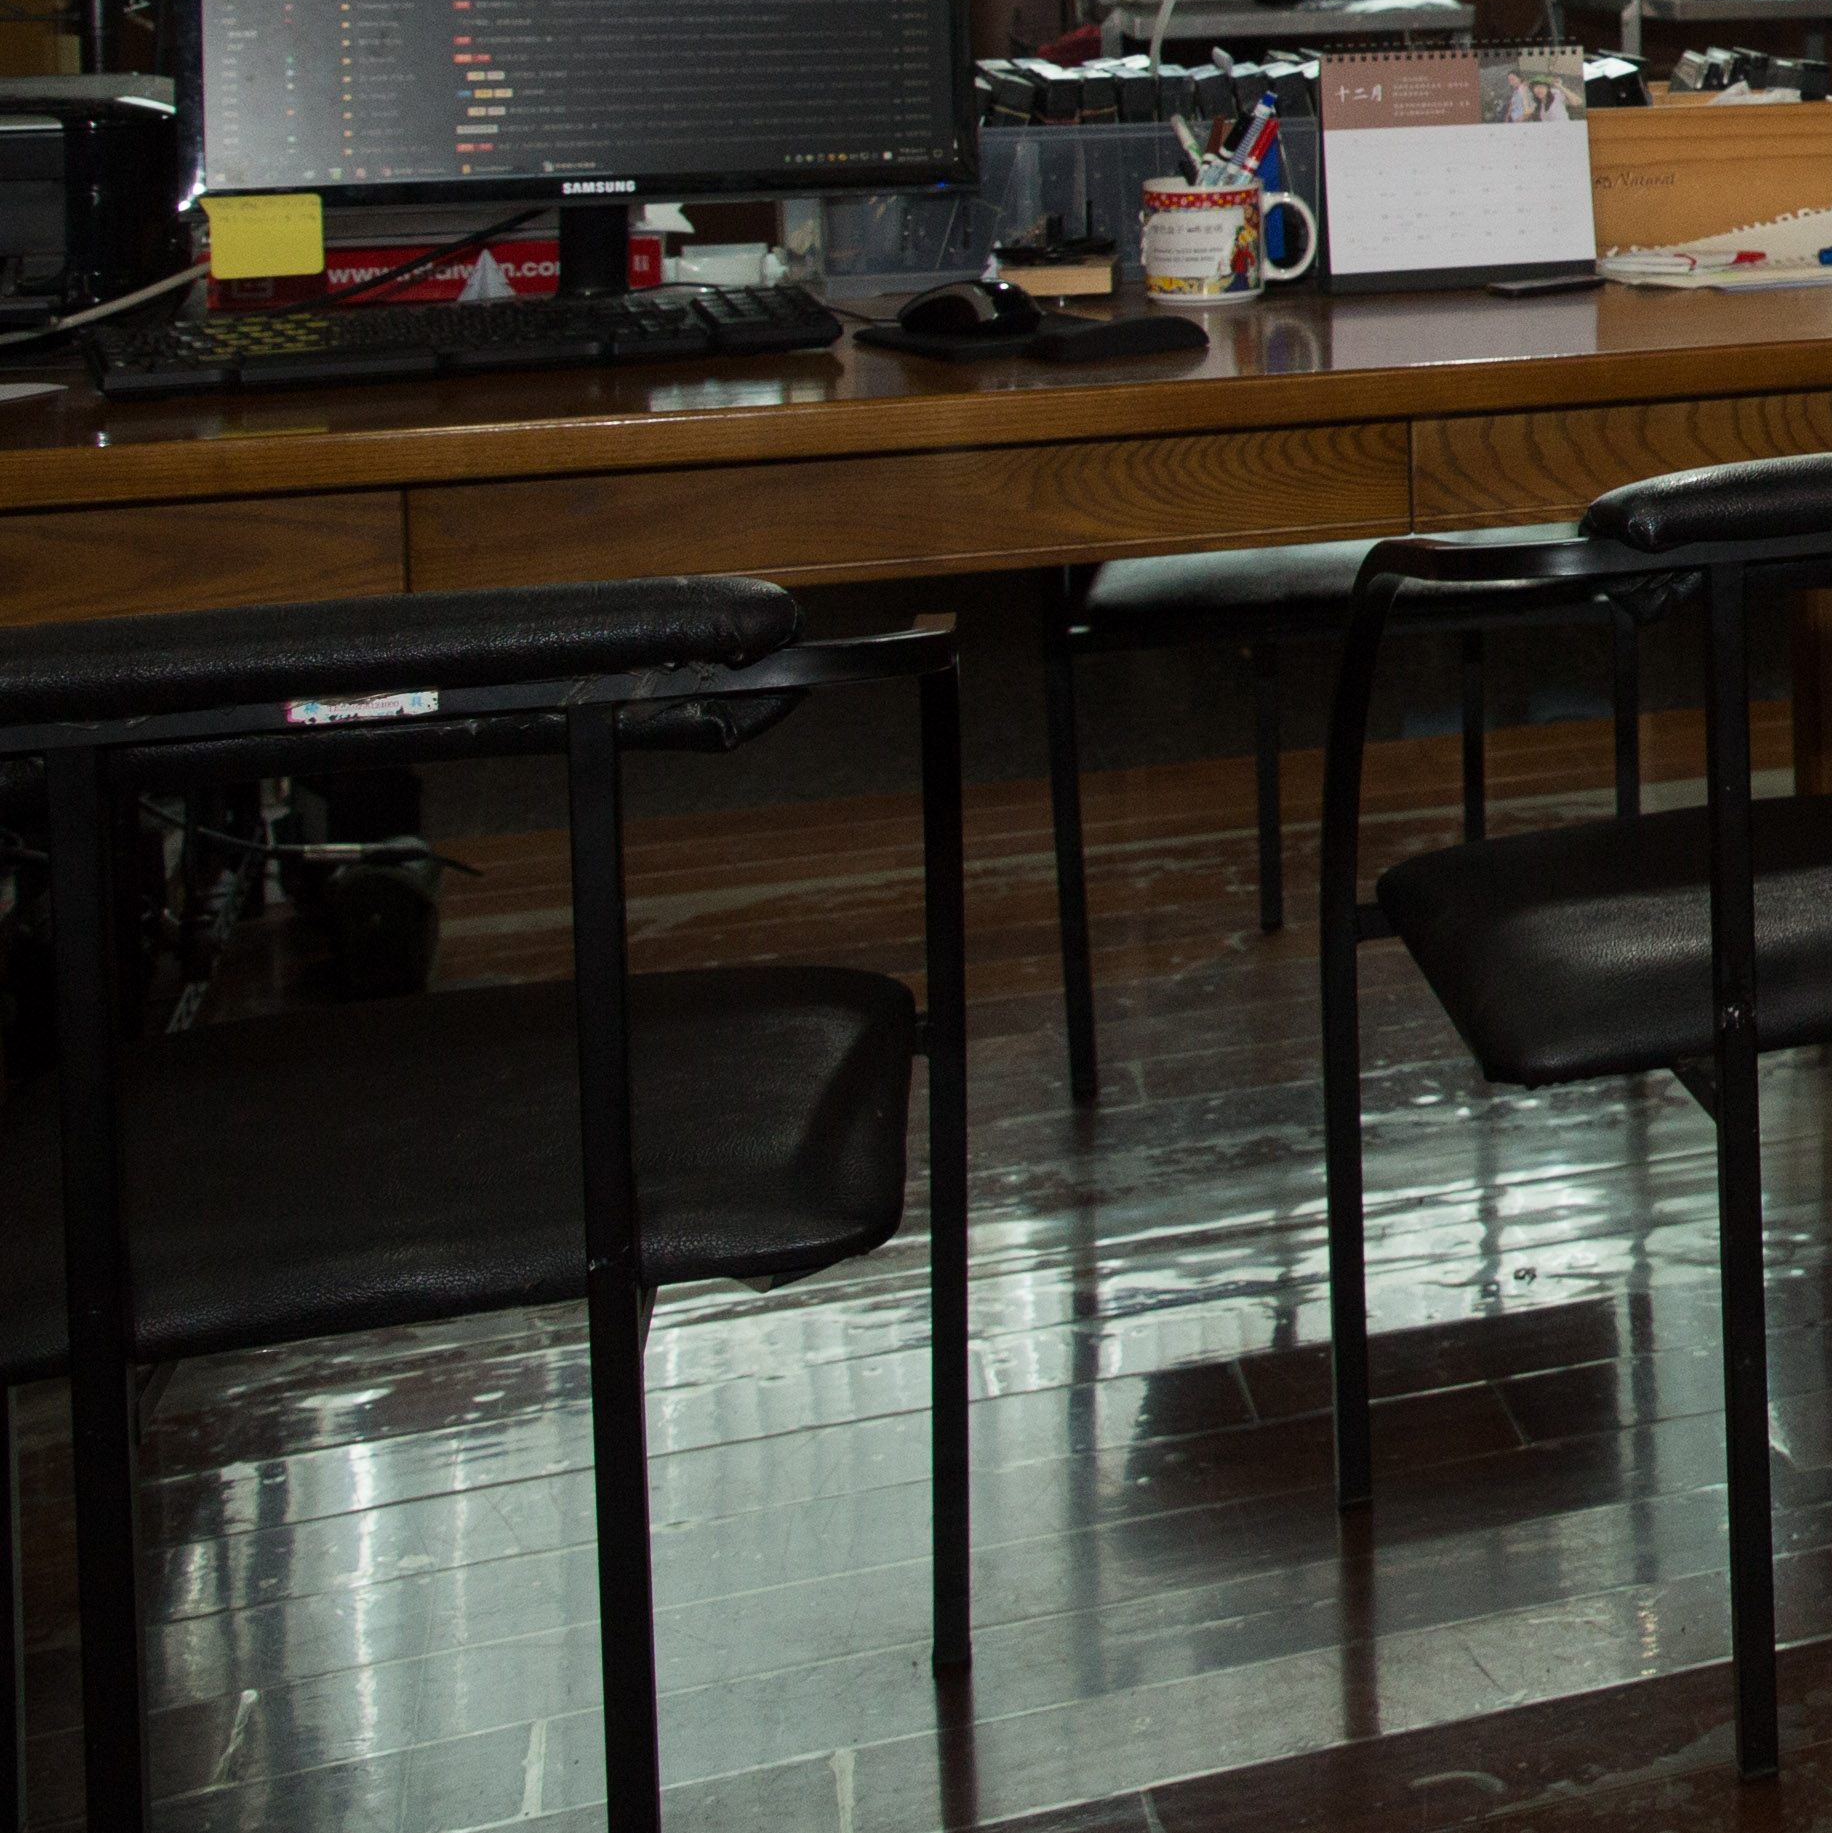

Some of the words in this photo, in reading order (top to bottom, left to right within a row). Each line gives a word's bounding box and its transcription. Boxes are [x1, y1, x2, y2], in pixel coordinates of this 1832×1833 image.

[1335, 84, 1383, 103] 十二月
[1616, 171, 1675, 187] Natural
[562, 180, 636, 195] SAMSUNG
